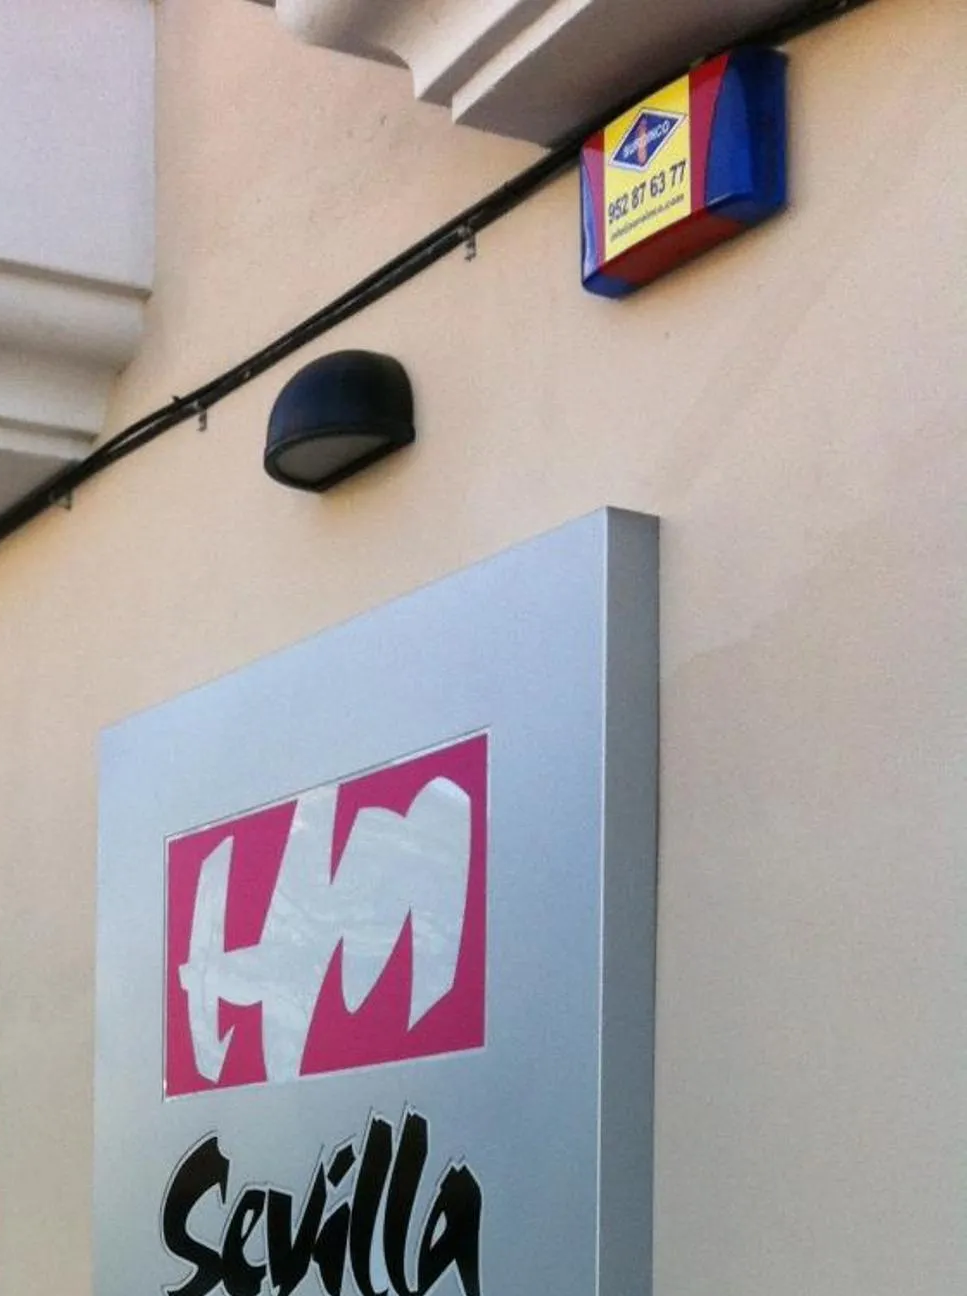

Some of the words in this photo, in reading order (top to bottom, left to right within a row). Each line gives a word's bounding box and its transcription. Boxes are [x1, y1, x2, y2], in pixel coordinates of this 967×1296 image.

[608, 194, 629, 224] 952
[631, 182, 646, 209] 87
[650, 172, 666, 197] 63
[670, 160, 687, 187] 77
[178, 776, 472, 1083] HM
